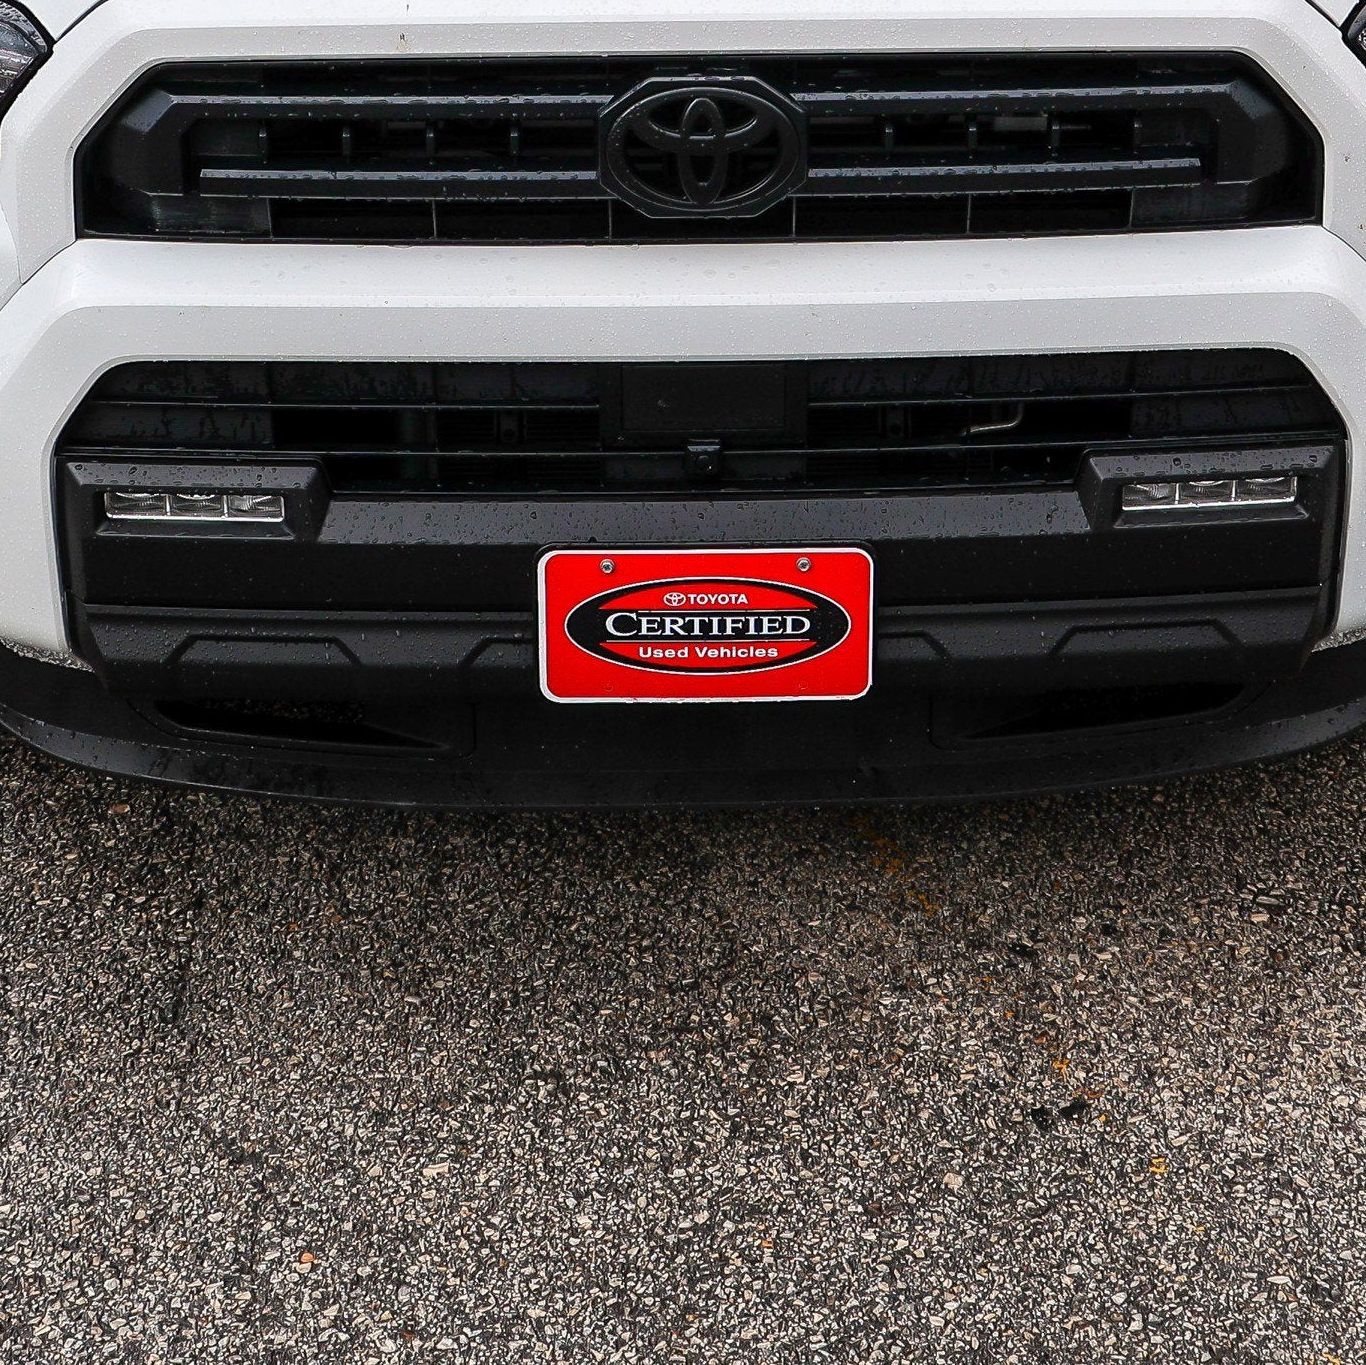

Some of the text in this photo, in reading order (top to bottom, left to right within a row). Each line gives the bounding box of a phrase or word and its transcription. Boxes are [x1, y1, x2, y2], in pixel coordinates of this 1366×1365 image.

[687, 593, 749, 605] TOYOTA
[605, 612, 812, 637] CERTIFIED
[638, 646, 779, 658] Used Vehicles
